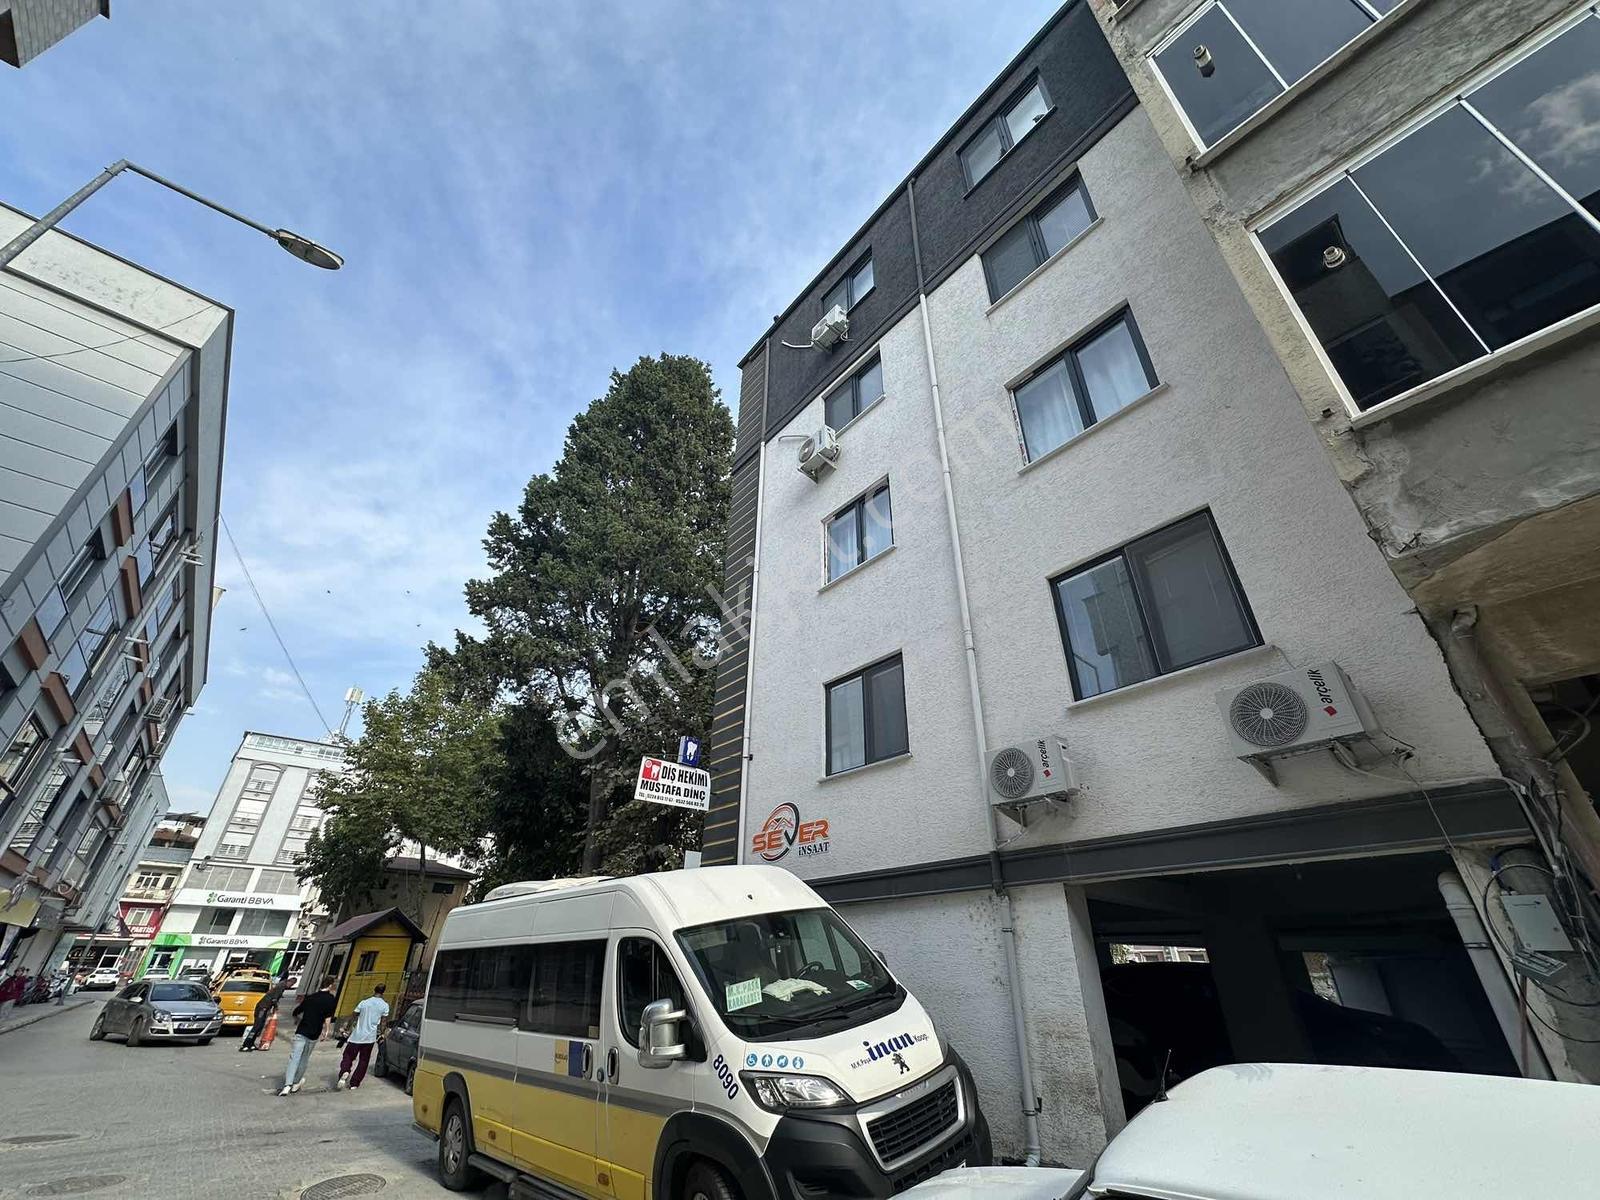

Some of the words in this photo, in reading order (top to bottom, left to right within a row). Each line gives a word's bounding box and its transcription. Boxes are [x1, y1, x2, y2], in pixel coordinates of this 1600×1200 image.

[1307, 669, 1333, 703] arçelik
[1037, 740, 1050, 768] arçelik
[661, 764, 677, 783] DİŞ
[678, 769, 708, 787] HEKİMİ
[640, 780, 682, 796] MUSTAFA
[683, 786, 706, 802] DİNÇ
[752, 819, 829, 853] SEVER
[217, 894, 247, 904] Garanti
[248, 896, 274, 905] BBVA
[206, 937, 229, 945] Garanti
[713, 1054, 739, 1100] 8090
